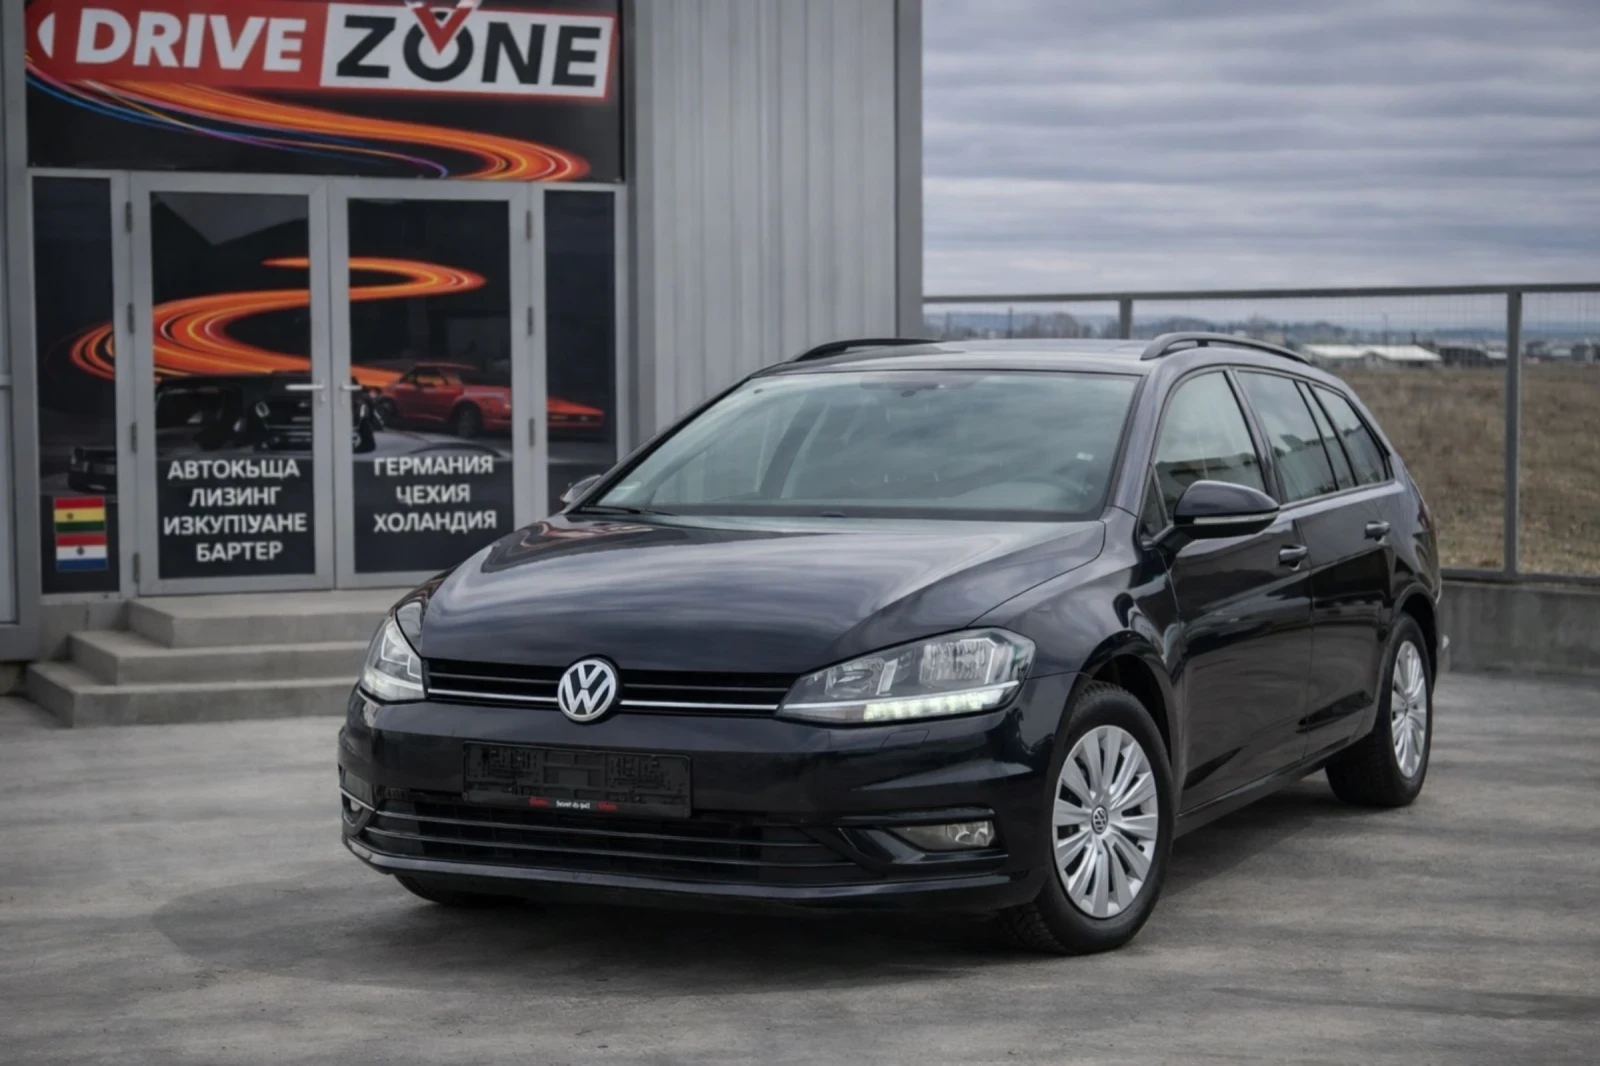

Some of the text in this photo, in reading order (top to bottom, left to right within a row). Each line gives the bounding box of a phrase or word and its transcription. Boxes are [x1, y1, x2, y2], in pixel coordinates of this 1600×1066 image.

[75, 8, 602, 87] DRIVE ZONE
[374, 455, 494, 476] ГЕРМАНИЯ
[189, 486, 282, 507] ЛИЗИНГ
[373, 510, 497, 534] ХОЛАНДИЯ
[196, 541, 283, 562] БАРТЕР
[558, 659, 617, 722] VW
